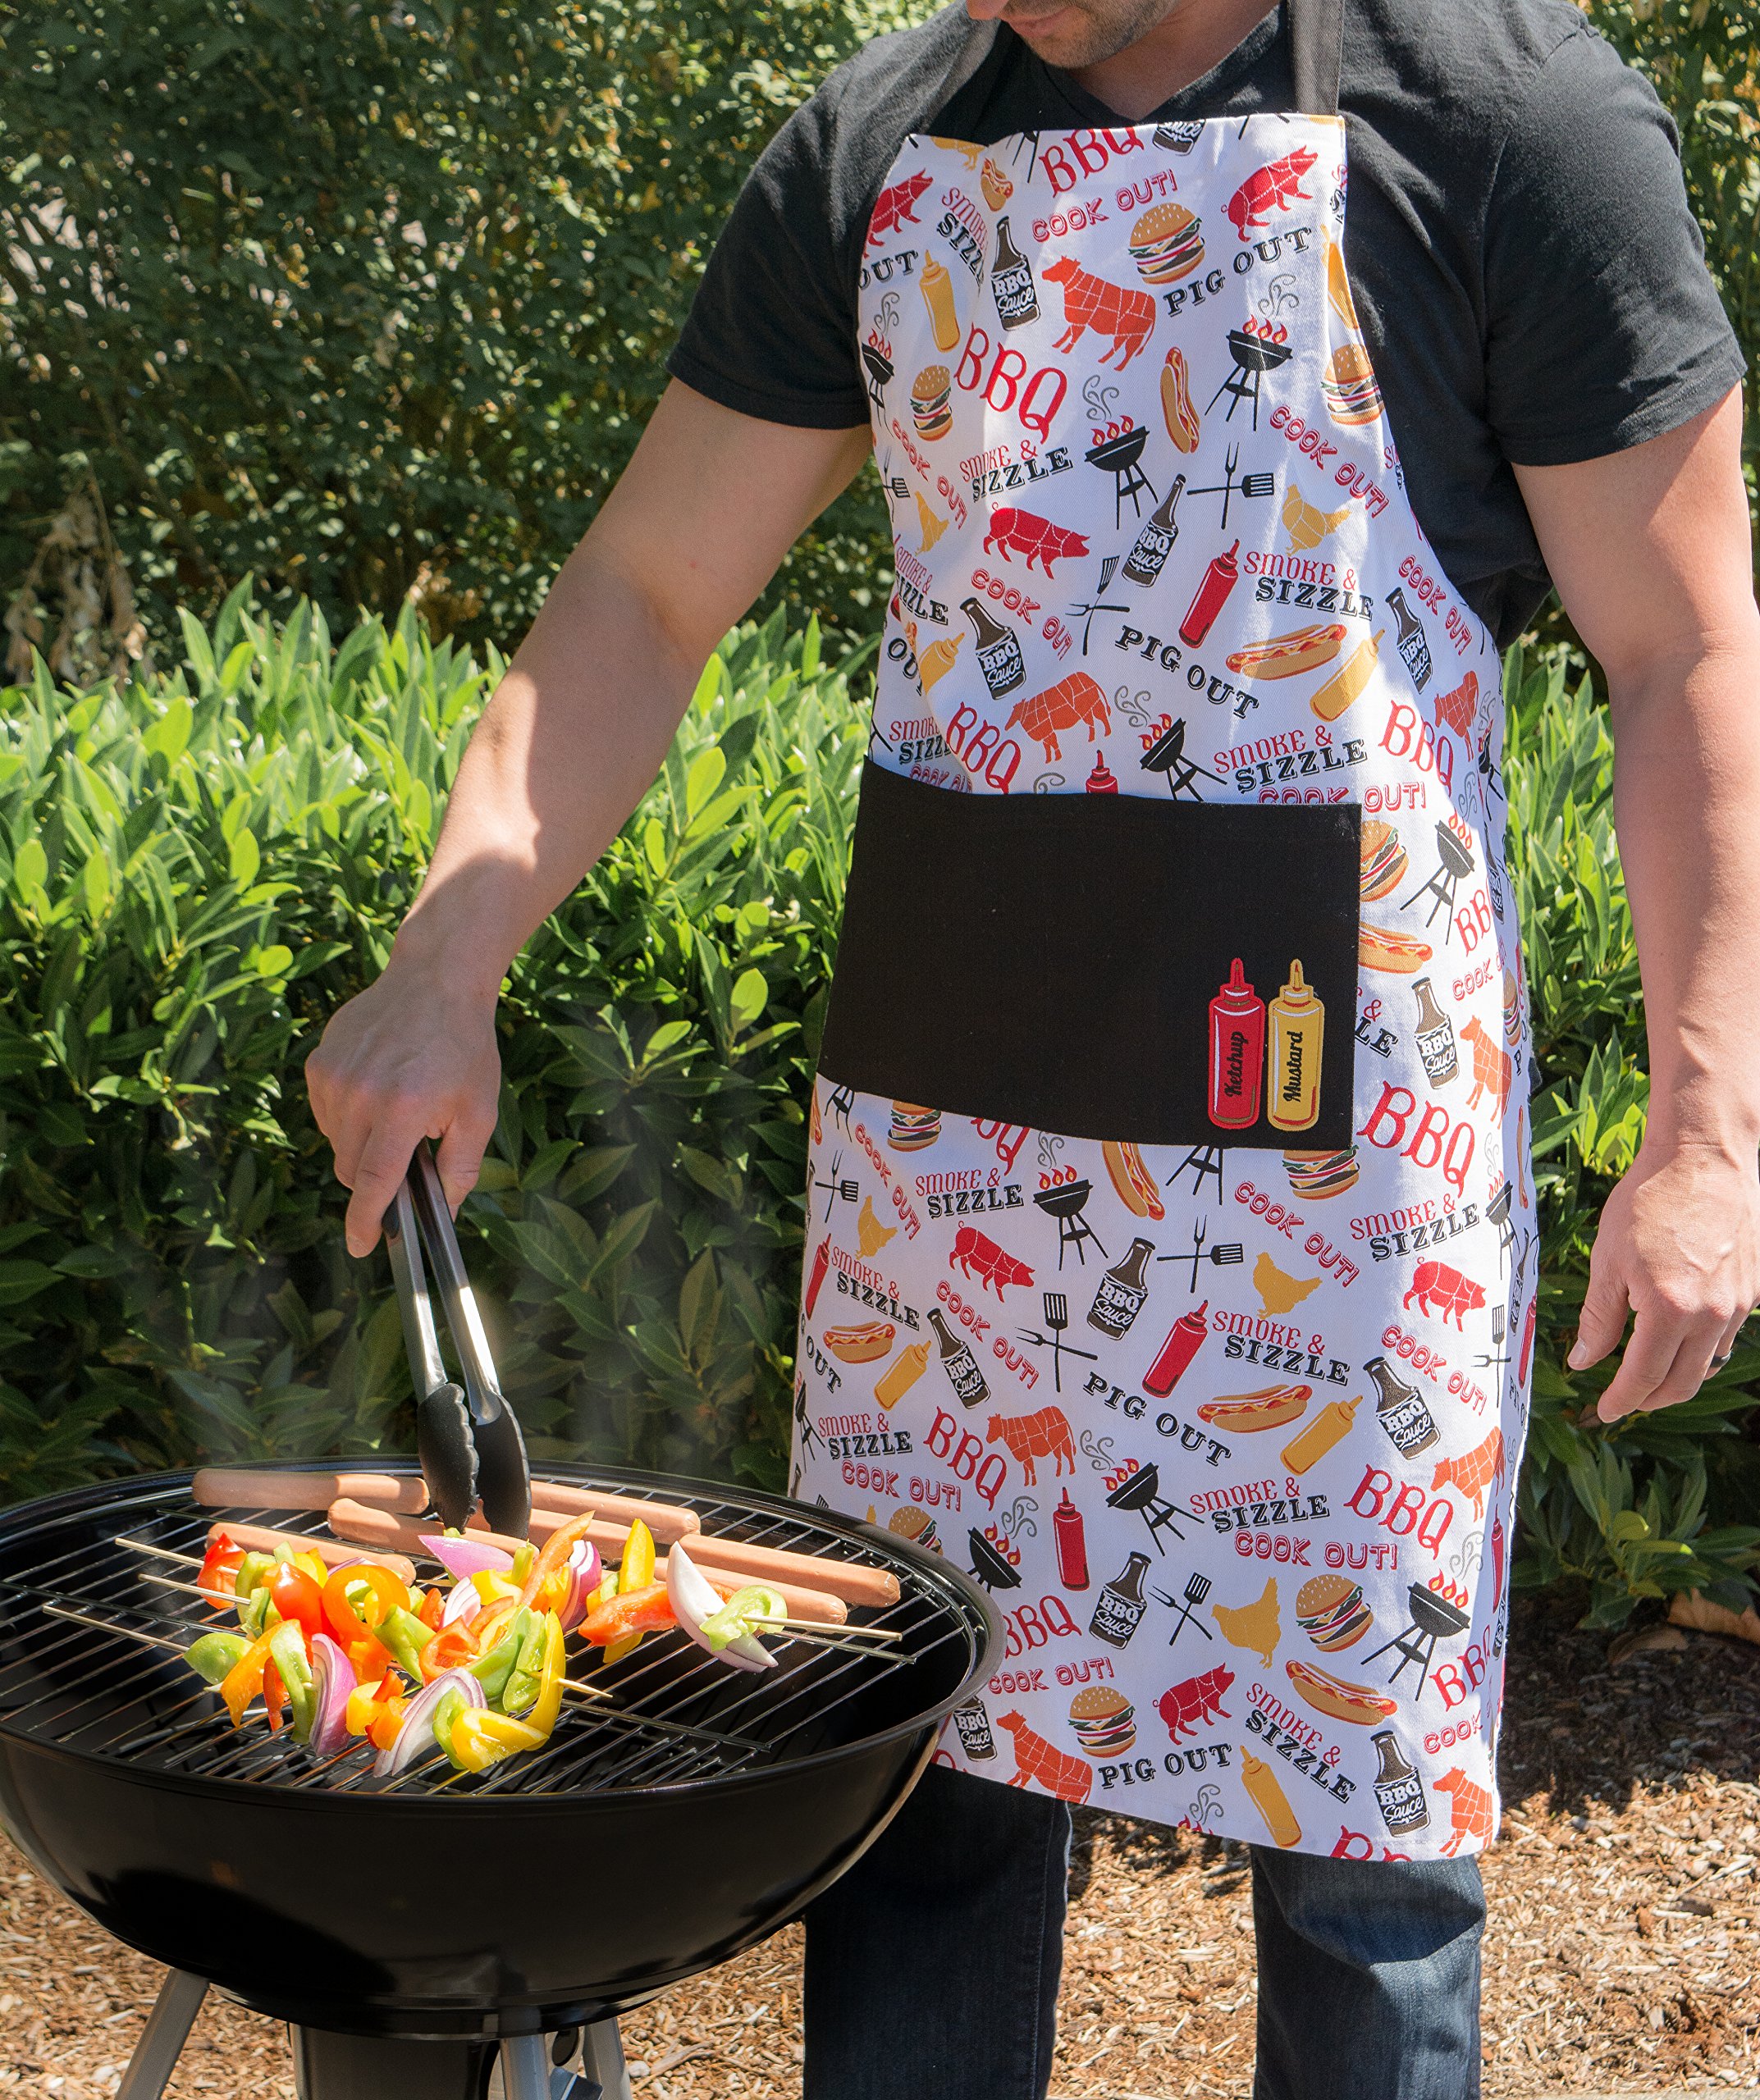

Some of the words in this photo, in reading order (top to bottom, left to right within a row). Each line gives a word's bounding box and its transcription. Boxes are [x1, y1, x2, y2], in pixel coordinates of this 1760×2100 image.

[942, 187, 988, 250] SMOK
[1032, 198, 1109, 243] COOK
[1116, 169, 1177, 211] OUT!
[936, 212, 985, 287] SIZZ
[1163, 269, 1226, 317] PIG
[1232, 227, 1312, 276] OUT
[994, 269, 1032, 297] BBQ
[998, 287, 1034, 317] Sauce
[953, 322, 1067, 445] BBQ
[891, 417, 930, 482] COOK
[937, 473, 968, 530] OUT!
[959, 445, 1012, 483] SMOKE
[1020, 439, 1038, 461] &
[972, 446, 1073, 504] SIZZLE
[1270, 404, 1338, 470] COOK
[1334, 461, 1389, 518] OUT!
[1128, 545, 1163, 569] Sauce
[1138, 527, 1170, 554] BBQ
[921, 573, 934, 596] &
[1243, 551, 1336, 586] SMOKE
[1342, 568, 1356, 591] &
[971, 568, 1040, 625] COOK
[1255, 576, 1374, 621] SIZZLE
[1398, 554, 1447, 616] COOK
[1445, 605, 1474, 656] OUT!
[982, 640, 1020, 672] BBQ
[987, 657, 1022, 687] Sauce
[1115, 624, 1182, 673] PIG
[1187, 664, 1259, 719] OUT
[1401, 636, 1427, 664] BBQ
[946, 701, 1022, 795] BBQ
[1214, 729, 1306, 774] SMOKE
[1314, 725, 1333, 746] &
[1235, 738, 1368, 794] SIZZLE
[1378, 700, 1454, 799] BBQ
[1364, 781, 1426, 813] OUT!
[1453, 876, 1494, 957] BB
[1451, 958, 1493, 1002] COOK
[1363, 999, 1382, 1023] &
[1223, 1031, 1249, 1098] Ketchup
[1421, 1029, 1453, 1056] BBQ
[1424, 1047, 1456, 1075] Sauce
[1282, 1030, 1303, 1102] Mustard
[1356, 1080, 1478, 1198] BBQ
[855, 1123, 892, 1188] COOK
[892, 1185, 921, 1240] OUT!
[916, 1169, 981, 1197] SMOKE
[986, 1167, 1001, 1187] &
[927, 1184, 1025, 1219] SIZZLE
[1234, 1180, 1304, 1240] COOK
[1304, 1232, 1360, 1287] OUT!
[1350, 1200, 1437, 1239] SMOKE
[1443, 1194, 1456, 1214] &
[1369, 1203, 1479, 1262] SIZZLE
[831, 1246, 884, 1292] SMOKE
[889, 1281, 900, 1300] &
[837, 1271, 920, 1331] SIZZLE
[1094, 1299, 1134, 1326] Sauce
[1100, 1281, 1140, 1311] BBQ
[936, 1280, 991, 1343] COOK
[992, 1335, 1040, 1390] OUT!
[1212, 1310, 1301, 1349] SMOKE
[1307, 1334, 1325, 1355] &
[807, 1335, 842, 1394] OUT
[947, 1356, 976, 1380] BBQ
[1224, 1335, 1351, 1386] SIZZLE
[1382, 1324, 1447, 1382] COOK
[1447, 1370, 1488, 1417] OUT!
[954, 1372, 981, 1398] Sauce
[818, 1414, 872, 1437] SMOKE
[877, 1413, 889, 1431] &
[1082, 1372, 1147, 1420] PIG
[1154, 1413, 1232, 1467] OUT
[1381, 1401, 1426, 1432] BBQ
[1393, 1415, 1431, 1448] Sauce
[828, 1431, 913, 1460] SIZZLE
[923, 1406, 1007, 1511] BBQ
[842, 1460, 900, 1499] COOK
[909, 1477, 962, 1512] OUT!
[1190, 1479, 1278, 1513] SMOKE
[1285, 1477, 1301, 1496] &
[1211, 1494, 1330, 1533] SIZZLE
[1343, 1463, 1453, 1560] BBQ
[1234, 1530, 1311, 1567] COOK
[1324, 1542, 1398, 1570] OUT!
[1095, 1609, 1134, 1636] Sauce
[1101, 1597, 1139, 1624] BBQ
[988, 1668, 1049, 1695] COOK
[1055, 1657, 1114, 1686] OUT!
[956, 1713, 987, 1730] BBQ
[959, 1730, 990, 1746] Sauce
[1246, 1682, 1323, 1751] SMOKE
[1323, 1746, 1341, 1769] &
[1423, 1709, 1483, 1754] COOK
[1099, 1758, 1156, 1789] PIG
[1164, 1742, 1232, 1776] OUT
[1246, 1709, 1357, 1804] SIZZLE
[1378, 1781, 1421, 1806] BBQ
[1383, 1796, 1424, 1824] Sauce
